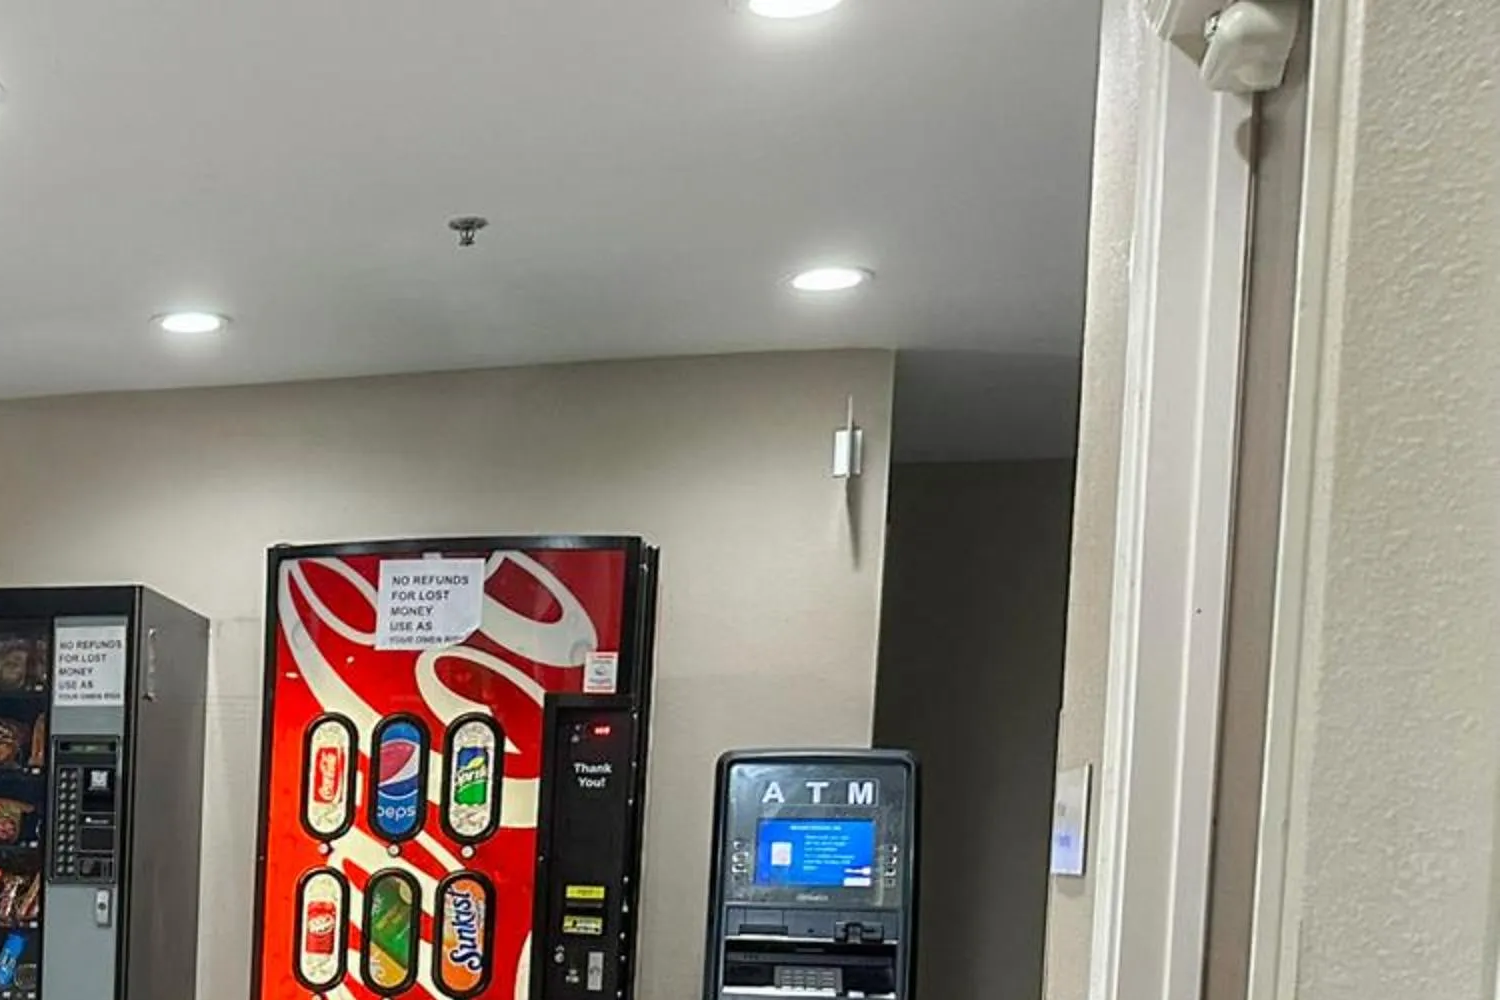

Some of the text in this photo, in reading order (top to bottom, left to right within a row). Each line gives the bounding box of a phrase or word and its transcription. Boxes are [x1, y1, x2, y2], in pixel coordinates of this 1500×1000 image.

[390, 575, 469, 586] NO REFUNDS
[390, 589, 449, 601] FOR LOST
[390, 606, 433, 617] MONEY
[389, 621, 433, 632] USE AS
[59, 639, 122, 651] NO REFUNDS
[59, 652, 107, 663] FOR LOST
[59, 666, 94, 677] MONEY
[572, 762, 612, 774] Thank
[577, 776, 606, 788] You!
[447, 885, 483, 971] Sunkist
